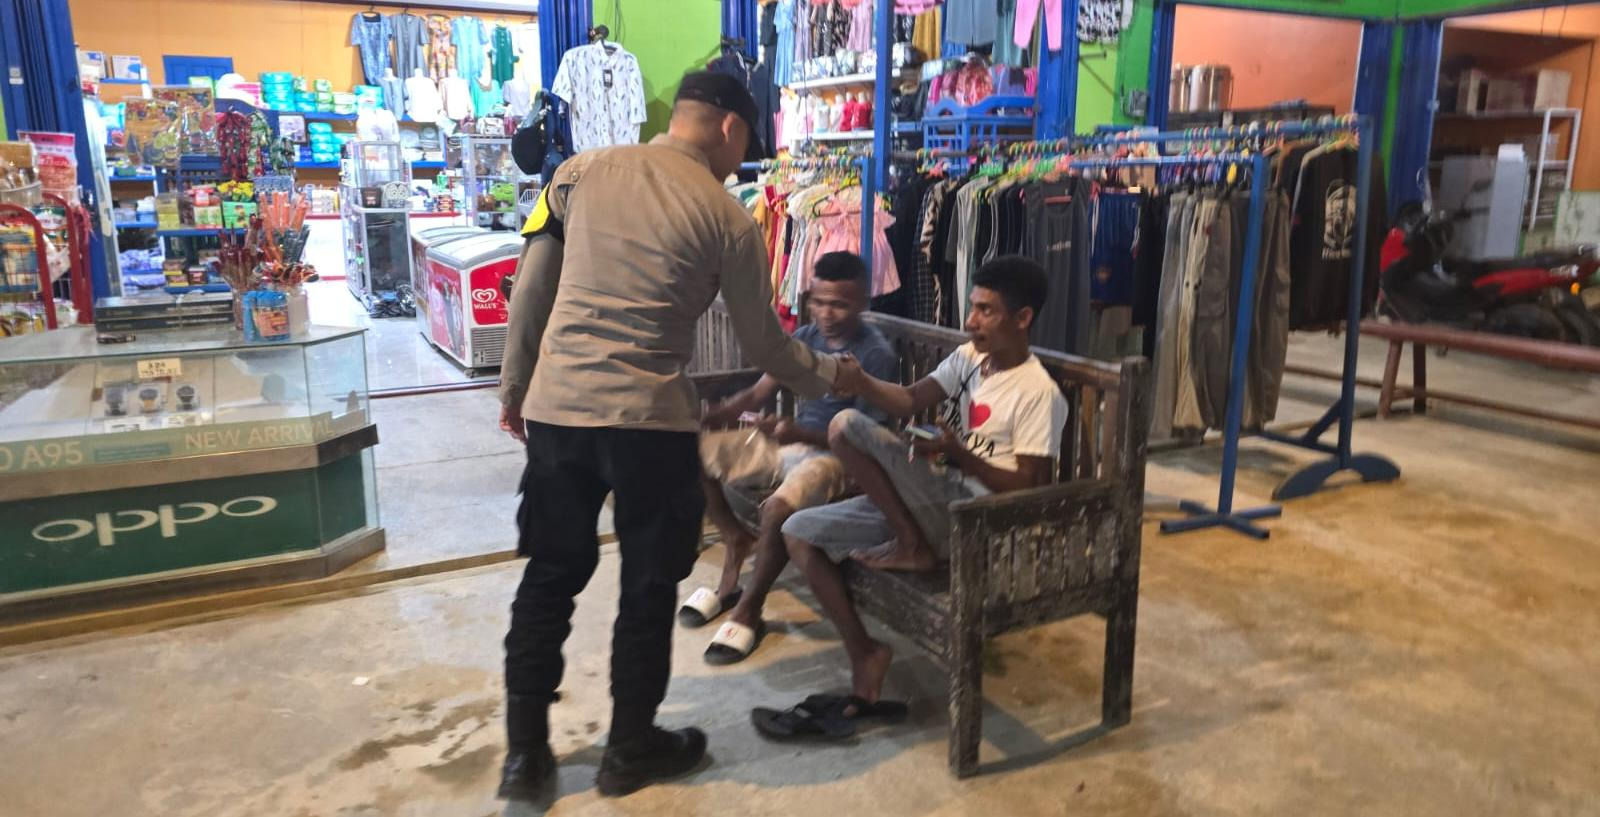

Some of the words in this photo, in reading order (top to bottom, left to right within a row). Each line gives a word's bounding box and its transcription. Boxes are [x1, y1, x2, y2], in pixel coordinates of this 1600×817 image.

[185, 430, 240, 450] NEW
[248, 418, 335, 445] ARRIVAL
[21, 441, 84, 469] A95
